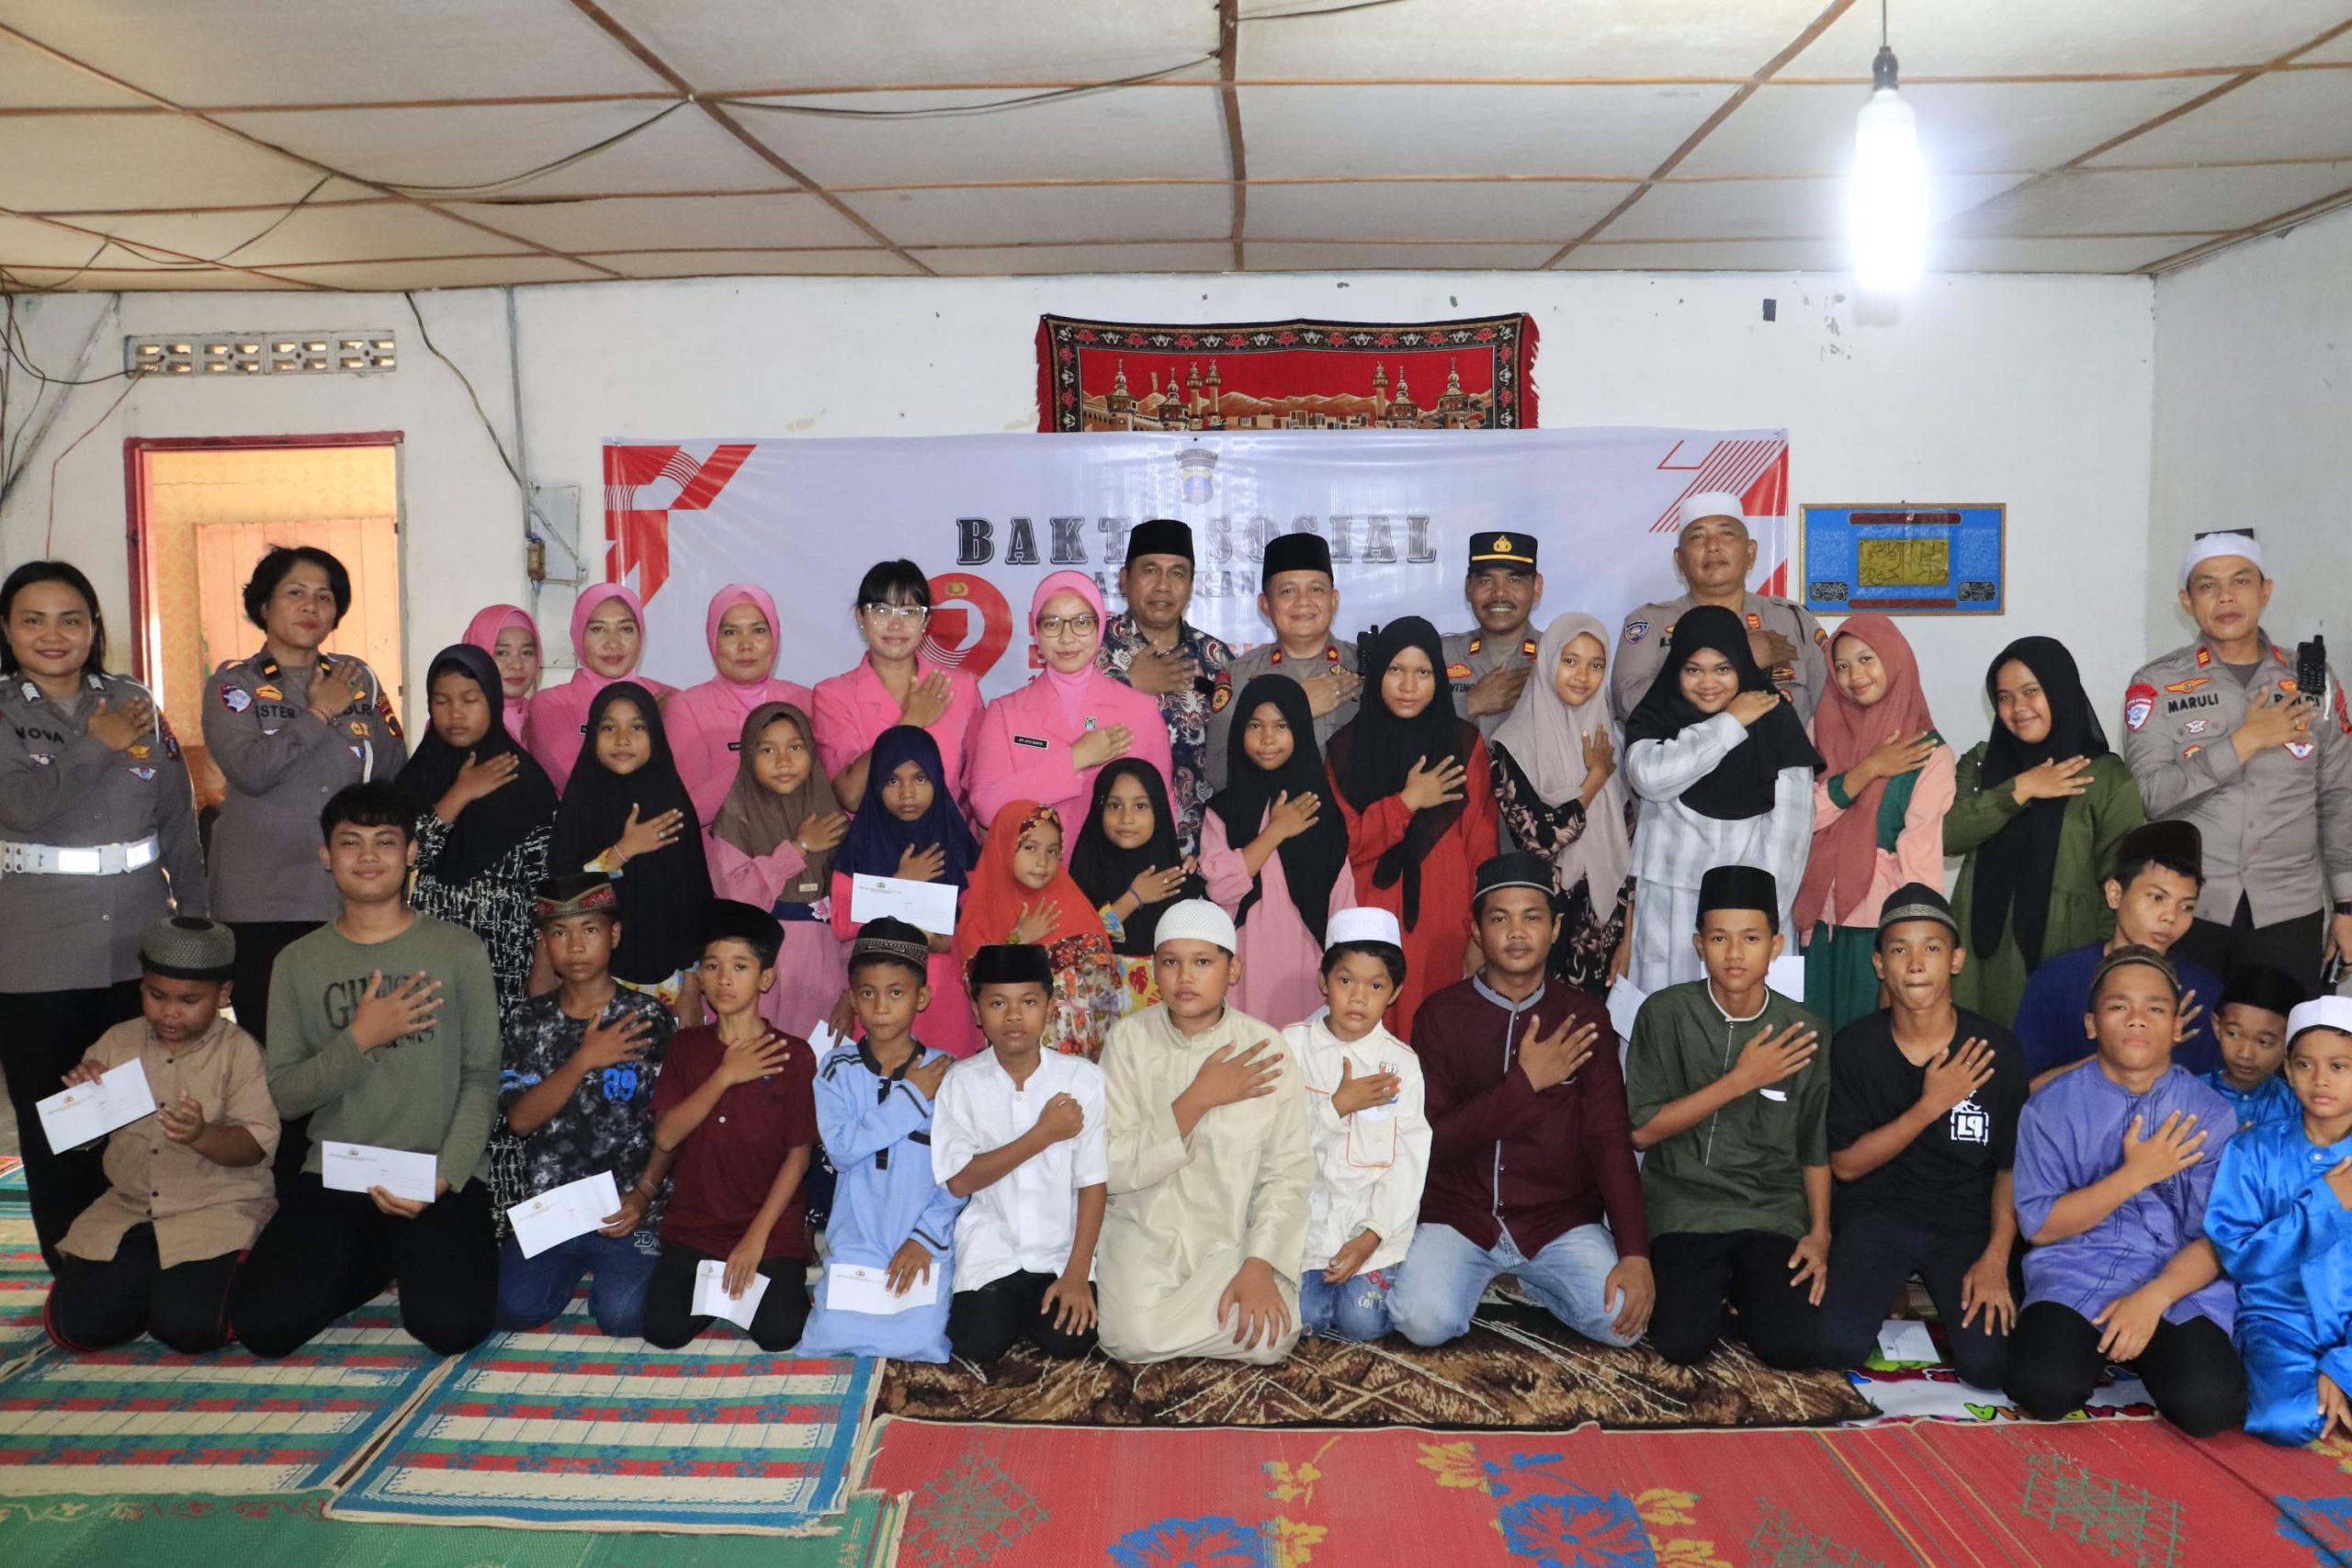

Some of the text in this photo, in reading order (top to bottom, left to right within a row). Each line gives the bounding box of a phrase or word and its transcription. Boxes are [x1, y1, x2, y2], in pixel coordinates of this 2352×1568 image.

[956, 516, 1159, 566] BAKT
[2168, 693, 2220, 714] MARULI
[15, 726, 64, 744] NOVA
